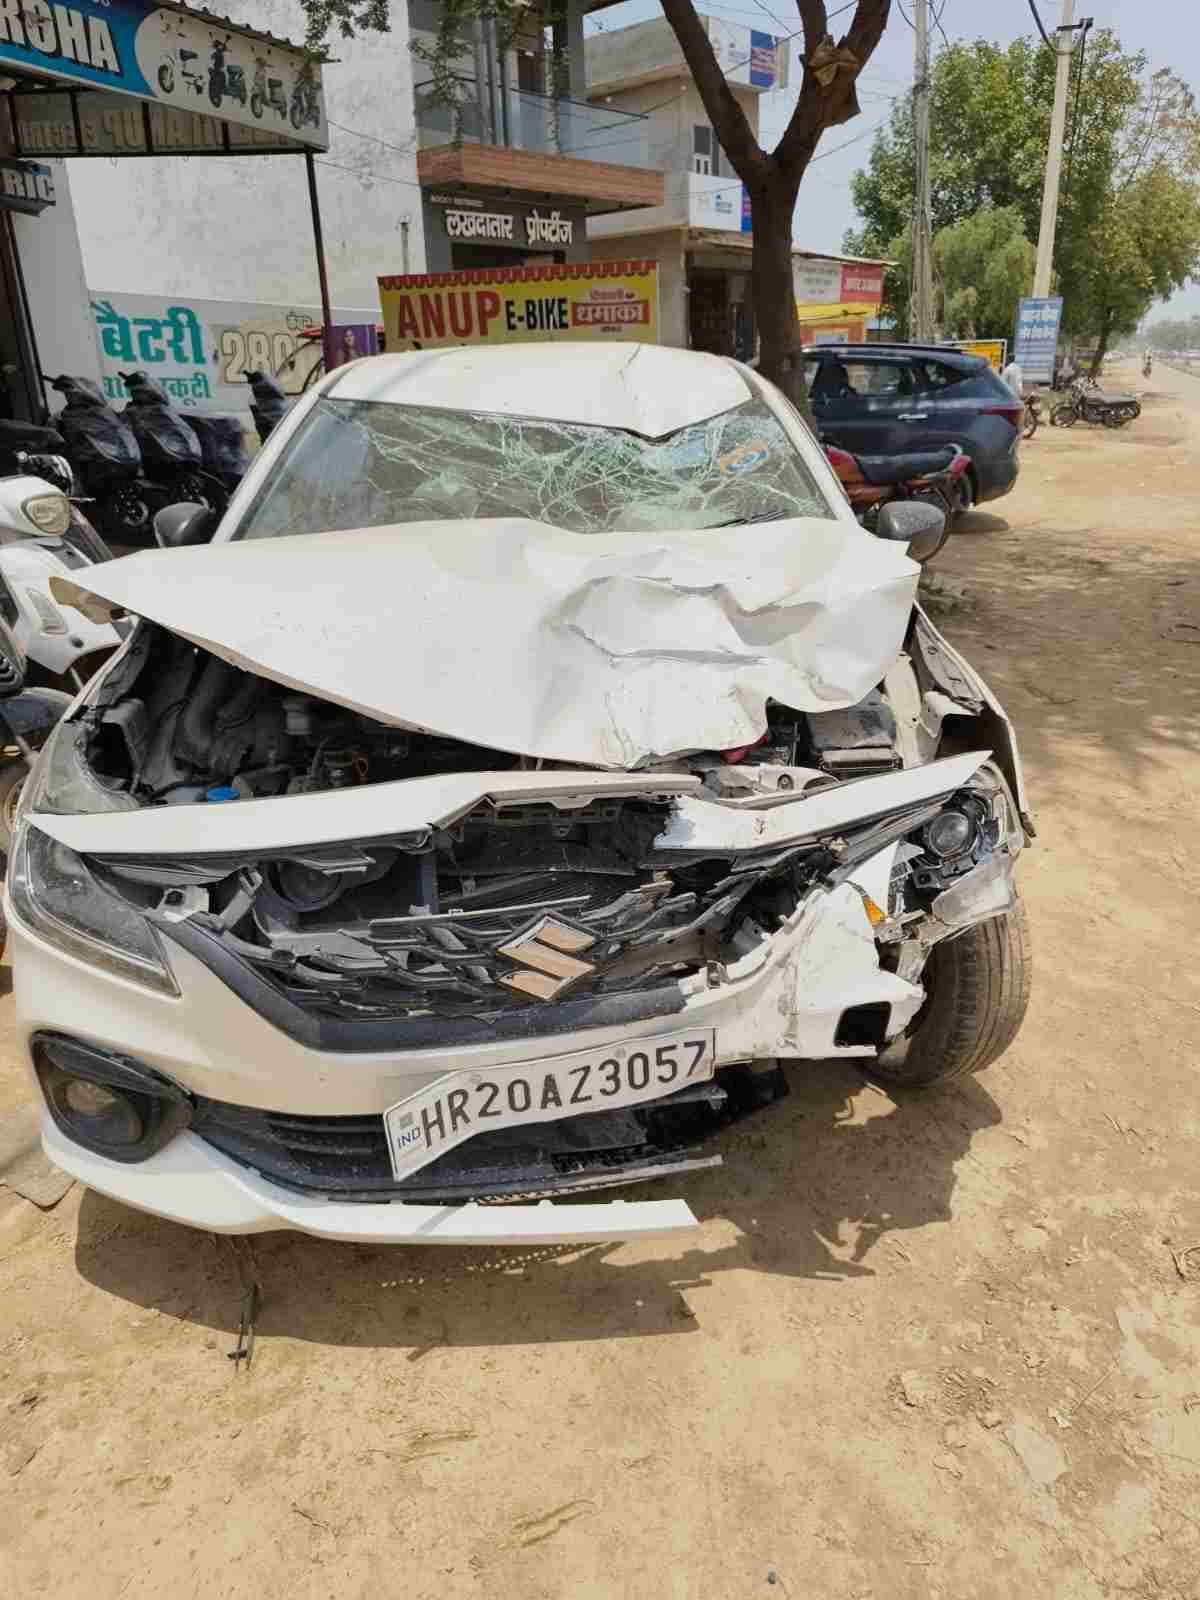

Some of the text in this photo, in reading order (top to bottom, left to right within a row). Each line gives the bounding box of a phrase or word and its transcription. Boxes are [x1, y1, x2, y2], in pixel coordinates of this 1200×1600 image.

[398, 290, 569, 340] ANUP E-BIKE
[420, 1039, 708, 1149] HR20AZ3057
[397, 1126, 421, 1148] IND
